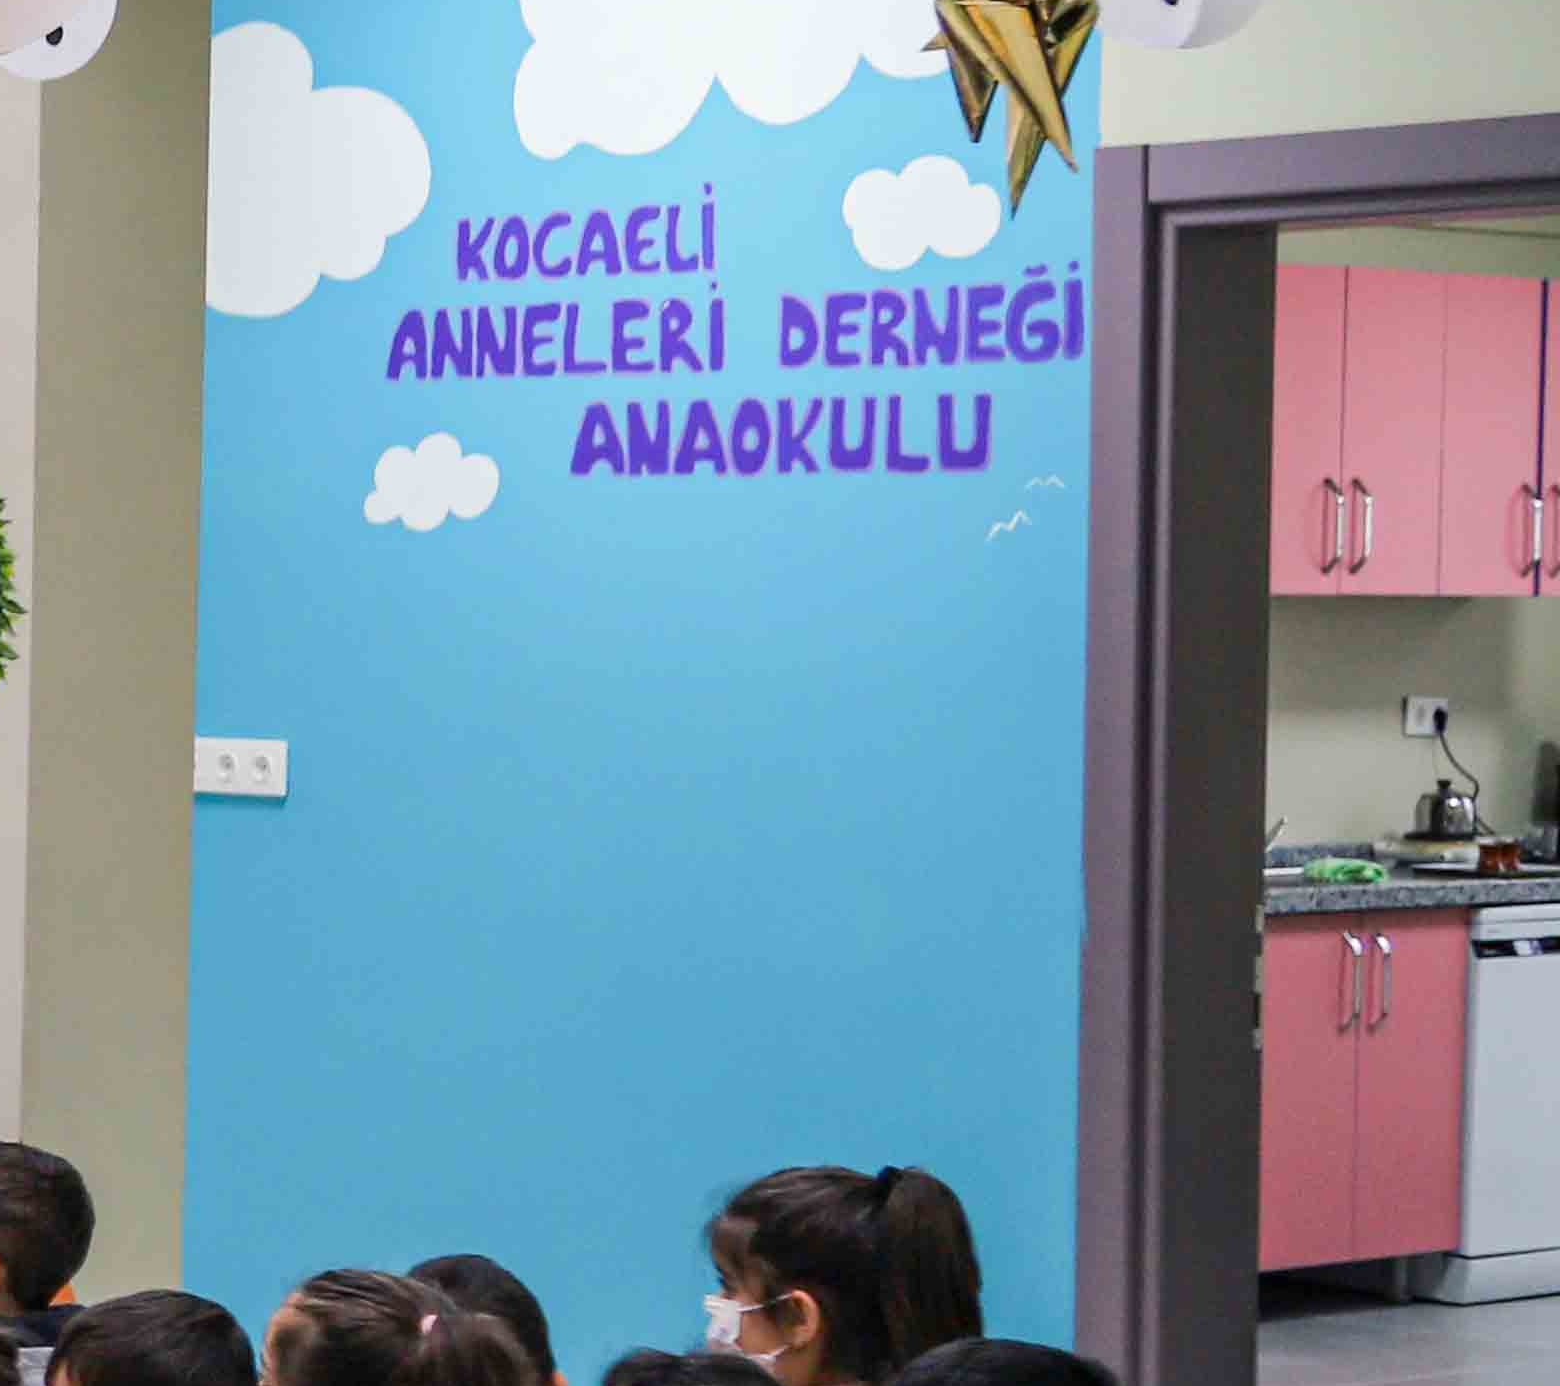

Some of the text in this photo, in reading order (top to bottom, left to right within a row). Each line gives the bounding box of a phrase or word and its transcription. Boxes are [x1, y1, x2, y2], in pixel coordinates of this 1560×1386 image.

[456, 182, 715, 281] KOCAELİ
[386, 261, 1084, 380] ANNELERİ DERNEĞİ
[569, 393, 993, 477] ANAOKULU
